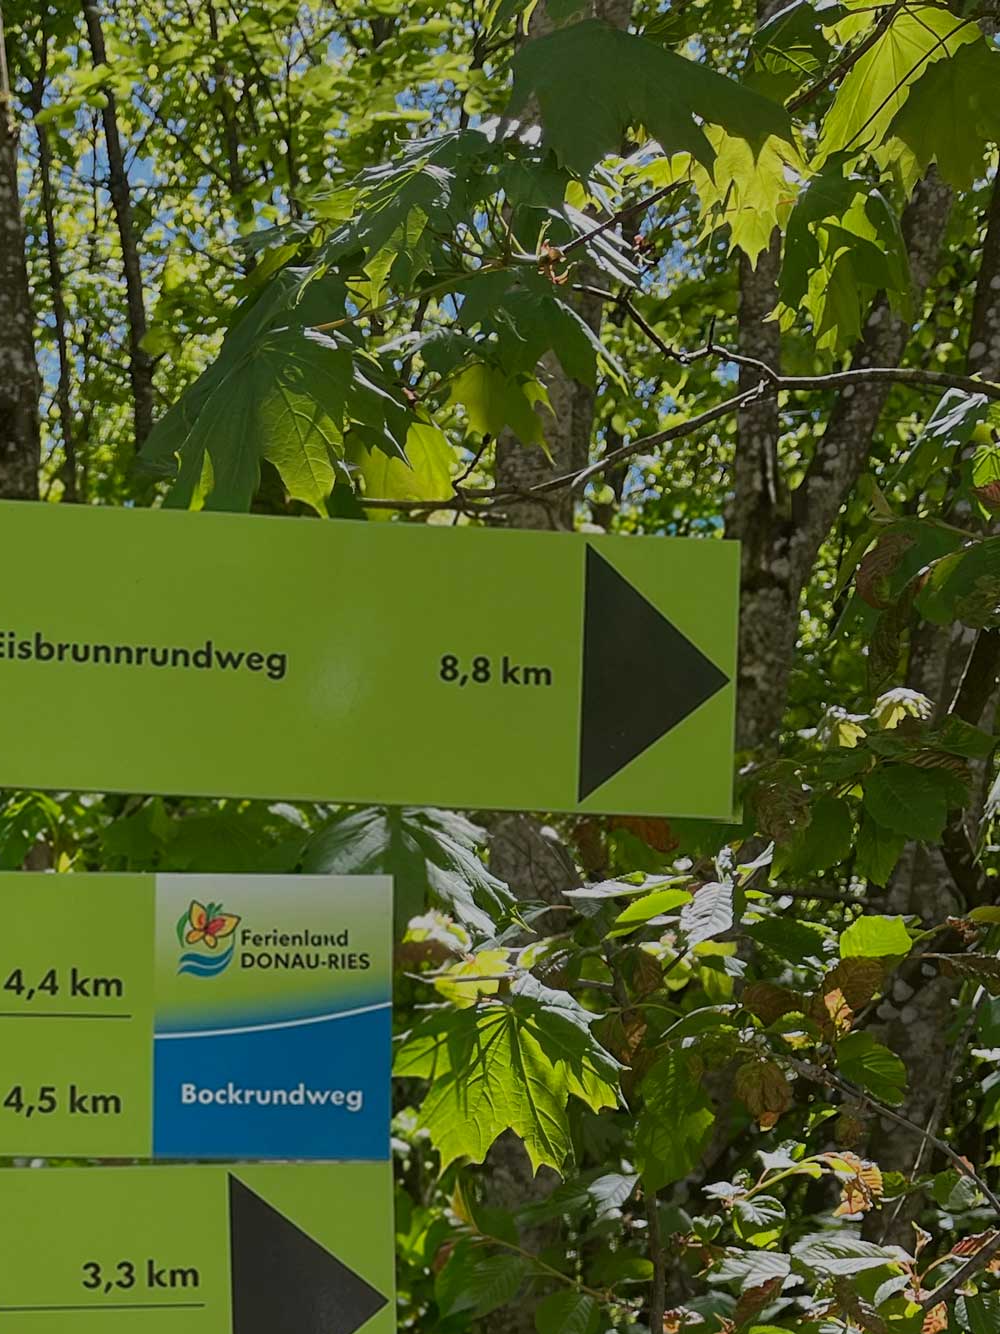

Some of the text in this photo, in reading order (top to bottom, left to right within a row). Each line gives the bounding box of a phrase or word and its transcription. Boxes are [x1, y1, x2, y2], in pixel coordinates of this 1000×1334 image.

[439, 654, 552, 687] 8,8 km
[241, 928, 349, 948] Ferienland
[240, 952, 371, 970] DONAU-RIES
[3, 967, 123, 1001] 4,4 km
[3, 1084, 121, 1118] 4,5 km
[181, 1082, 363, 1112] Bockrundweg
[82, 1259, 199, 1294] 3,3 km
